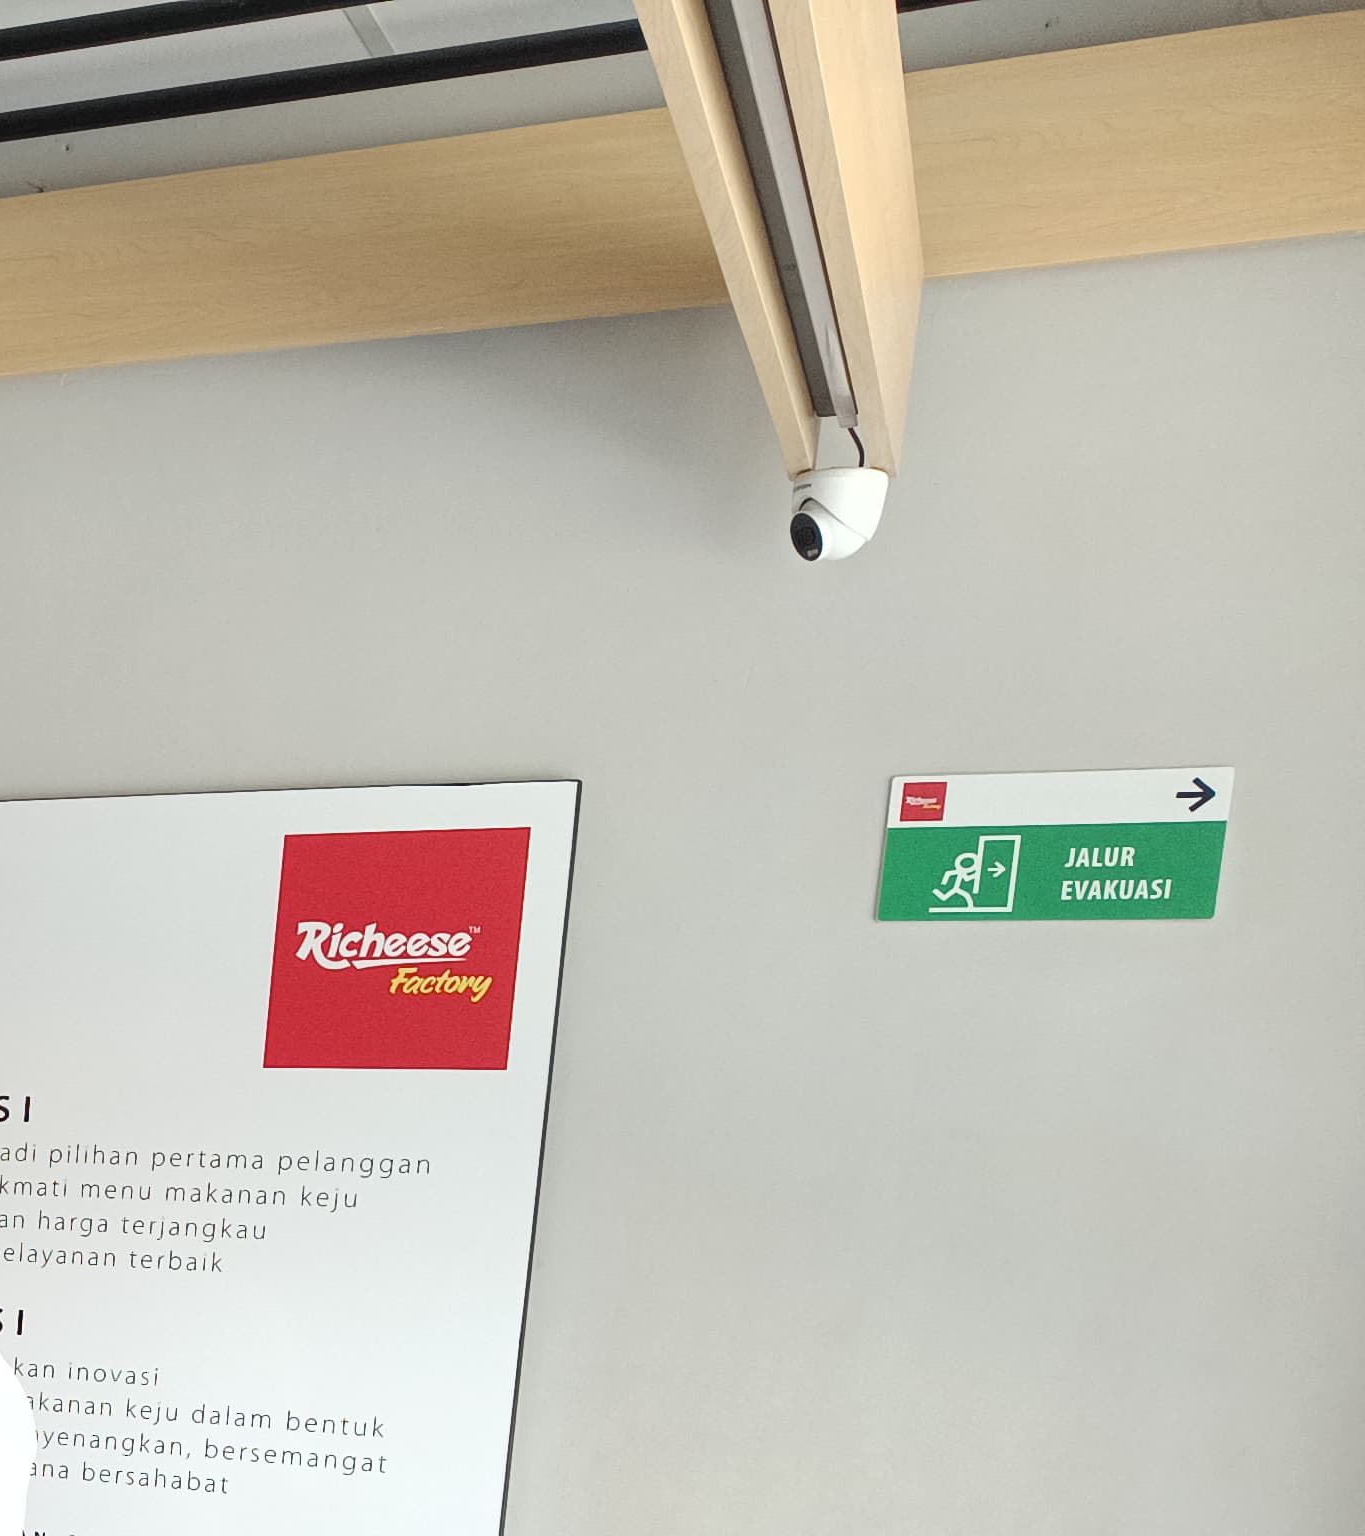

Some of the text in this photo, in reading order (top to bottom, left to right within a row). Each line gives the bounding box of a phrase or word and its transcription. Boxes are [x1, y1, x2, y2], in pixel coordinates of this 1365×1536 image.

[1064, 846, 1136, 869] JALUR
[1060, 878, 1173, 901] EVAKUASI
[295, 921, 473, 970] Richeese
[388, 967, 493, 1004] Factory
[50, 1144, 137, 1168] pilihan
[152, 1151, 262, 1171] pertama
[278, 1150, 429, 1178] pelanggan
[81, 1184, 150, 1200] menu
[166, 1182, 285, 1205] makanan
[301, 1185, 357, 1213] keju
[39, 1210, 107, 1237] harga
[121, 1217, 265, 1243] terjangkau
[129, 1250, 222, 1272] terbaik
[69, 1362, 158, 1386] inovasi
[27, 1392, 383, 1438] akanan keju dalam bentuk
[35, 1430, 386, 1475] yenangkan, bersemangat
[83, 1461, 228, 1494] bersahabat
